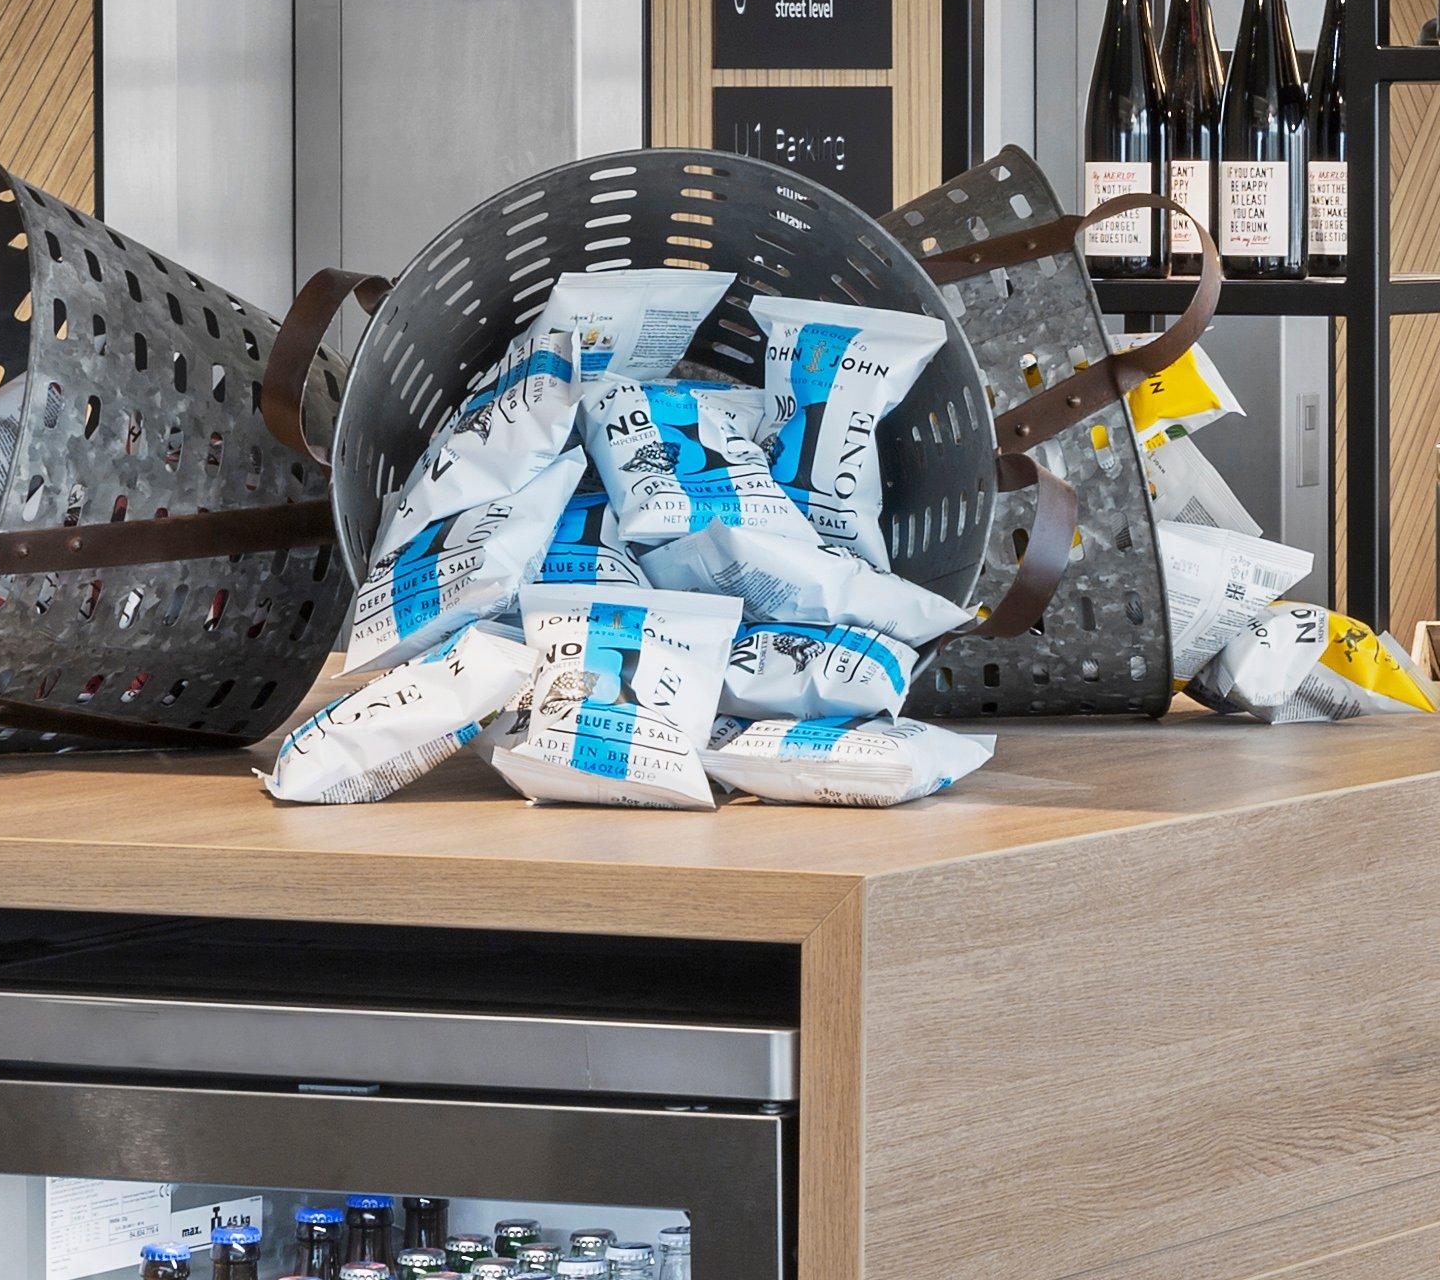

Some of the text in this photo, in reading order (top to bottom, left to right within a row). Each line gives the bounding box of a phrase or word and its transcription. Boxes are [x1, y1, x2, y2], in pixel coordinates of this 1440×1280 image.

[775, 0, 806, 18] street
[776, 128, 845, 170] Parking
[1250, 167, 1274, 178] CAN'T
[1231, 181, 1268, 193] BE HAPPY
[1231, 195, 1267, 205] AT LEAST
[1233, 209, 1265, 218] YOU CAN
[1103, 222, 1135, 231] FORGET
[1231, 222, 1268, 233] BE DRUNK
[830, 355, 889, 377] JOHN
[834, 411, 875, 500] ONE
[717, 482, 742, 492] SEA
[696, 502, 789, 514] IN BRITAIN
[819, 516, 848, 530] SALT
[359, 556, 477, 613] DEEP SEA SALT
[538, 615, 599, 630] JOHN
[576, 715, 643, 735] BLUE SEA
[578, 745, 684, 772] IN BRITAIN
[182, 1214, 251, 1238] max. 45 kg
